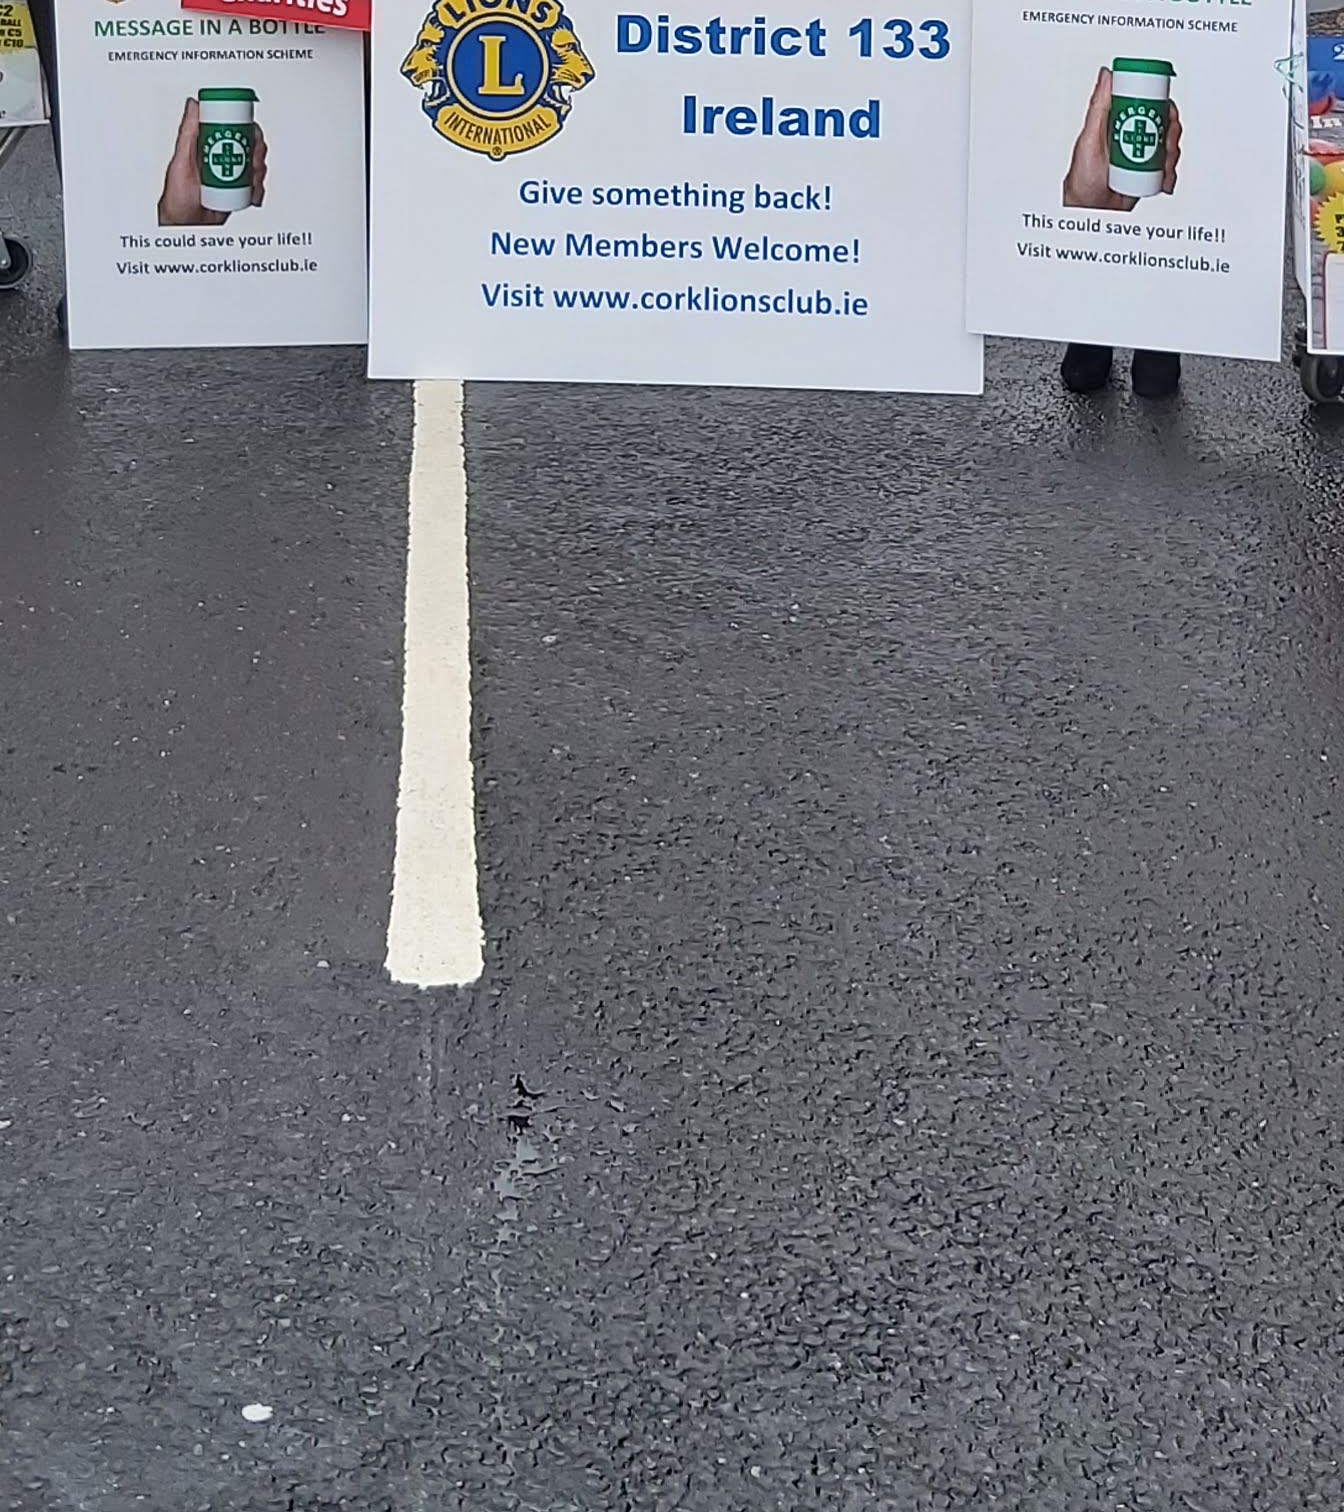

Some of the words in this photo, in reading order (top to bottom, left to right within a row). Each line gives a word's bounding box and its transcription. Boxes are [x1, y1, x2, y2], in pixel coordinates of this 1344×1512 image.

[95, 19, 193, 38] MESSAGE
[201, 19, 221, 36] IN
[228, 19, 243, 35] A
[616, 14, 827, 58] District
[848, 17, 952, 60] 133
[1023, 10, 1095, 27] EMERGENCY
[1098, 15, 1185, 30] INFORMATION
[1188, 20, 1238, 33] SCHEME
[108, 51, 178, 61] EMERGENCY
[181, 50, 264, 61] INFORMATION
[266, 49, 313, 60] SCHEME
[478, 34, 524, 96] L
[444, 112, 552, 146] INTERNATIONAL
[682, 94, 881, 139] Ireland
[520, 180, 584, 206] Give
[591, 183, 745, 214] something
[754, 184, 832, 211] back!
[120, 235, 151, 248] This
[154, 234, 196, 248] could
[200, 235, 234, 247] save
[238, 234, 273, 250] your
[277, 232, 312, 246] life!!
[1023, 213, 1053, 230] This
[1057, 217, 1101, 235] could
[1105, 222, 1142, 237] save
[1146, 224, 1183, 242] your
[1187, 226, 1226, 243] life!!
[491, 232, 555, 257] New
[565, 232, 702, 260] Members
[712, 235, 860, 264] Welcome!
[1017, 242, 1051, 259] Visit
[1056, 246, 1231, 274] www.corklionsclub.ie
[117, 260, 149, 276] Visit
[154, 259, 317, 274] www.corklionsclub.ie
[481, 282, 544, 309] Visit
[554, 284, 868, 316] www.corklionsclub.ie
